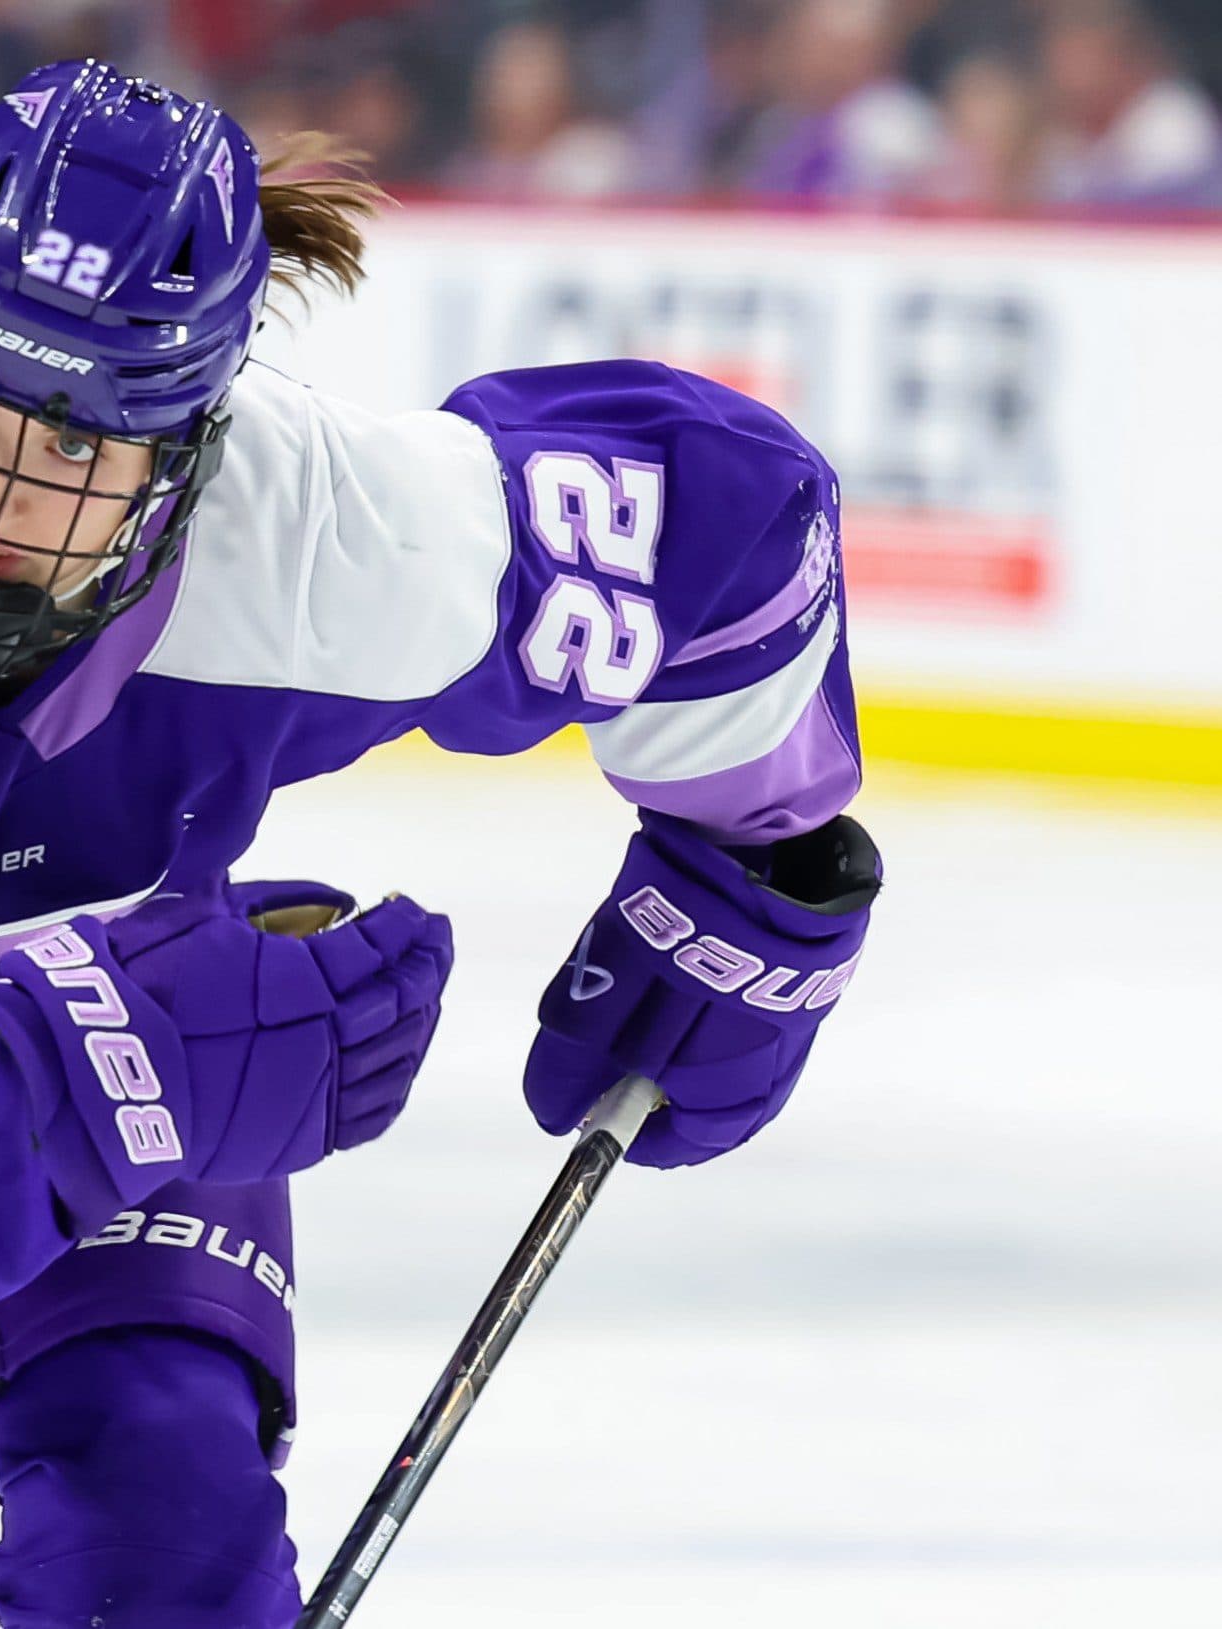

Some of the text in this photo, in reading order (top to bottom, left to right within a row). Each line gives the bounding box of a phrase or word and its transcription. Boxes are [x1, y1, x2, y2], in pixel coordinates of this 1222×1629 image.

[24, 228, 112, 299] 22
[516, 450, 666, 707] 22
[13, 923, 184, 1166] BAUE
